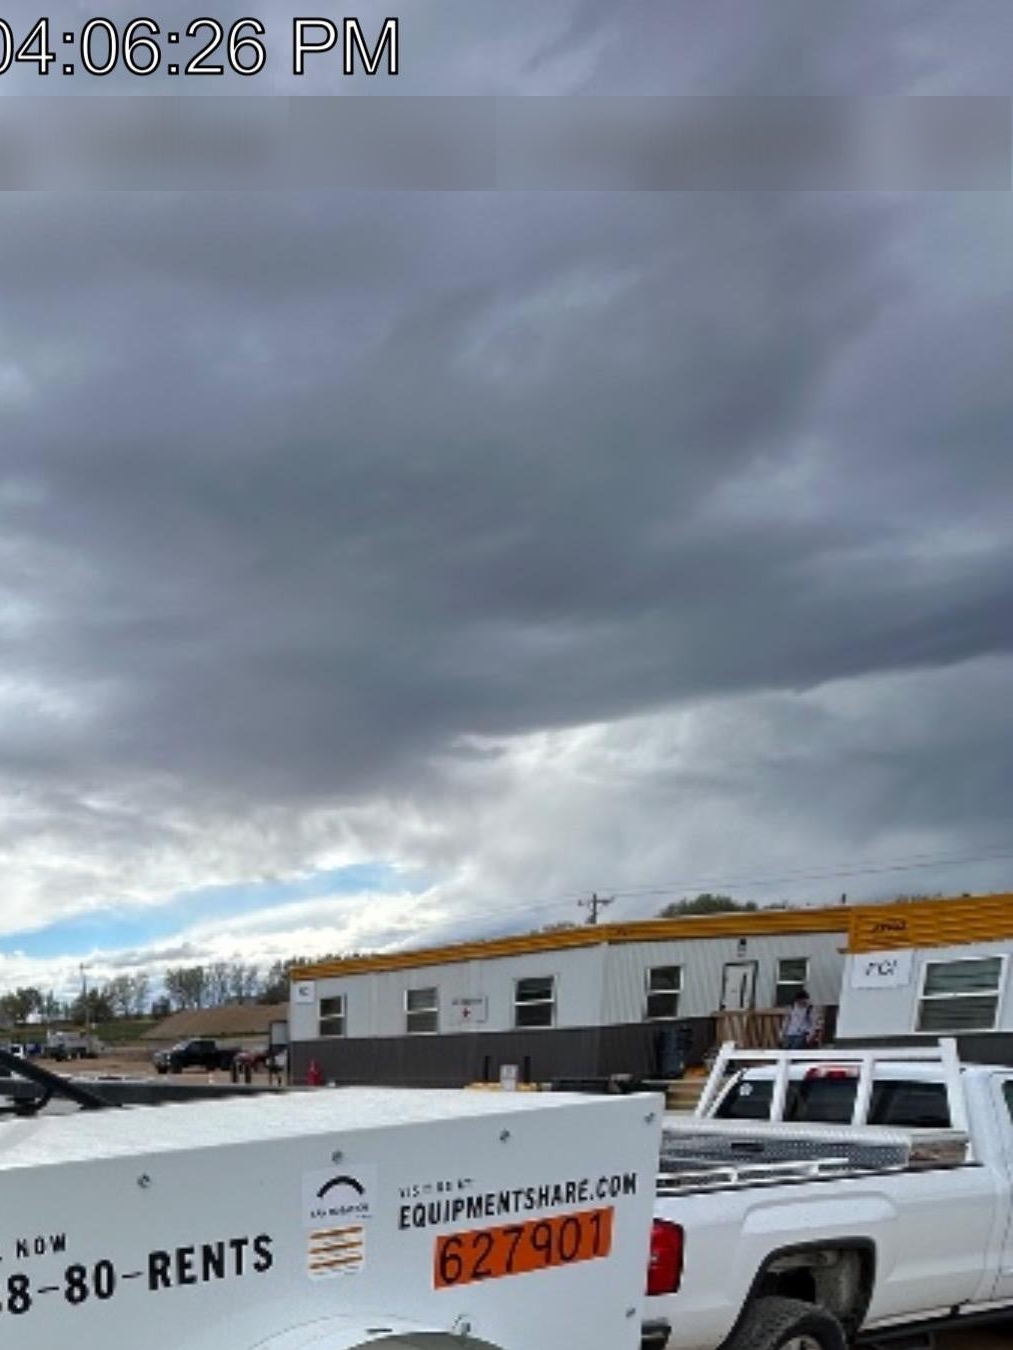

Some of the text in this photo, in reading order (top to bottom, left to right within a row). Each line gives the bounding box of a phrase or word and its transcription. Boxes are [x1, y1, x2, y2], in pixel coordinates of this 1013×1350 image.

[398, 1172, 638, 1231] EQUIPMENTSHARE.COM
[16, 1232, 68, 1259] NOW
[438, 1212, 603, 1286] 627901
